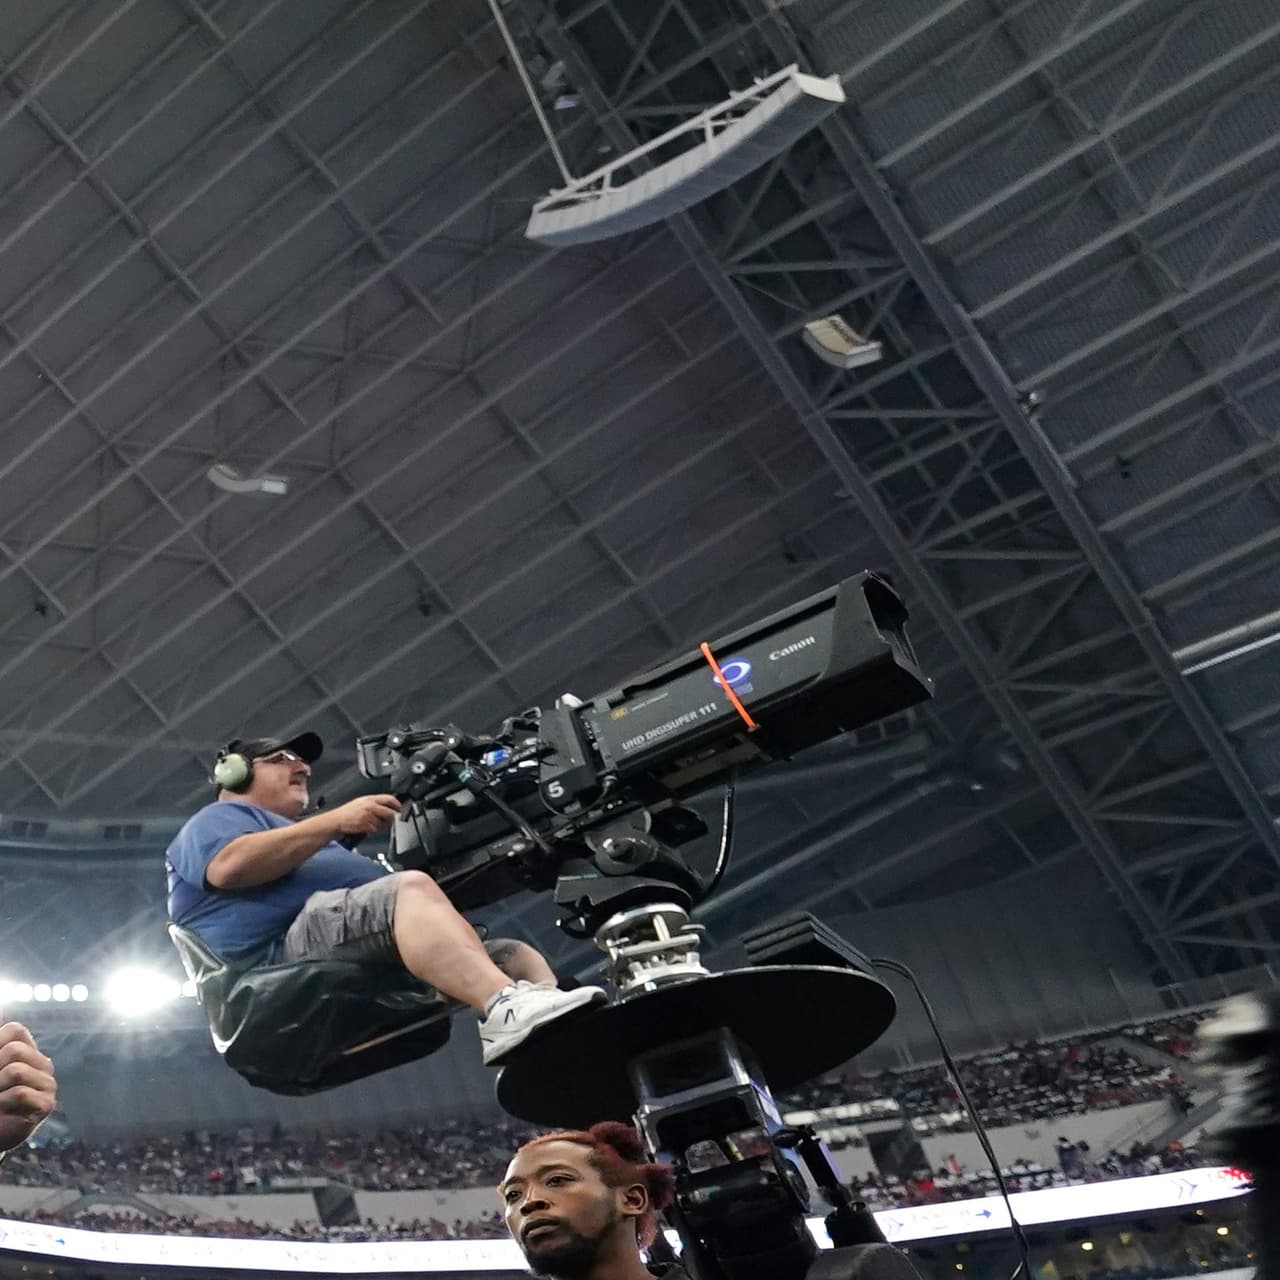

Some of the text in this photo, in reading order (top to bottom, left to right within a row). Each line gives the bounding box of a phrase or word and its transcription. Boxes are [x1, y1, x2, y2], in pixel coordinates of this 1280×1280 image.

[769, 635, 817, 661] Canon
[621, 735, 645, 750] UHD
[645, 711, 699, 742] DIGISUPER
[548, 780, 565, 799] 5
